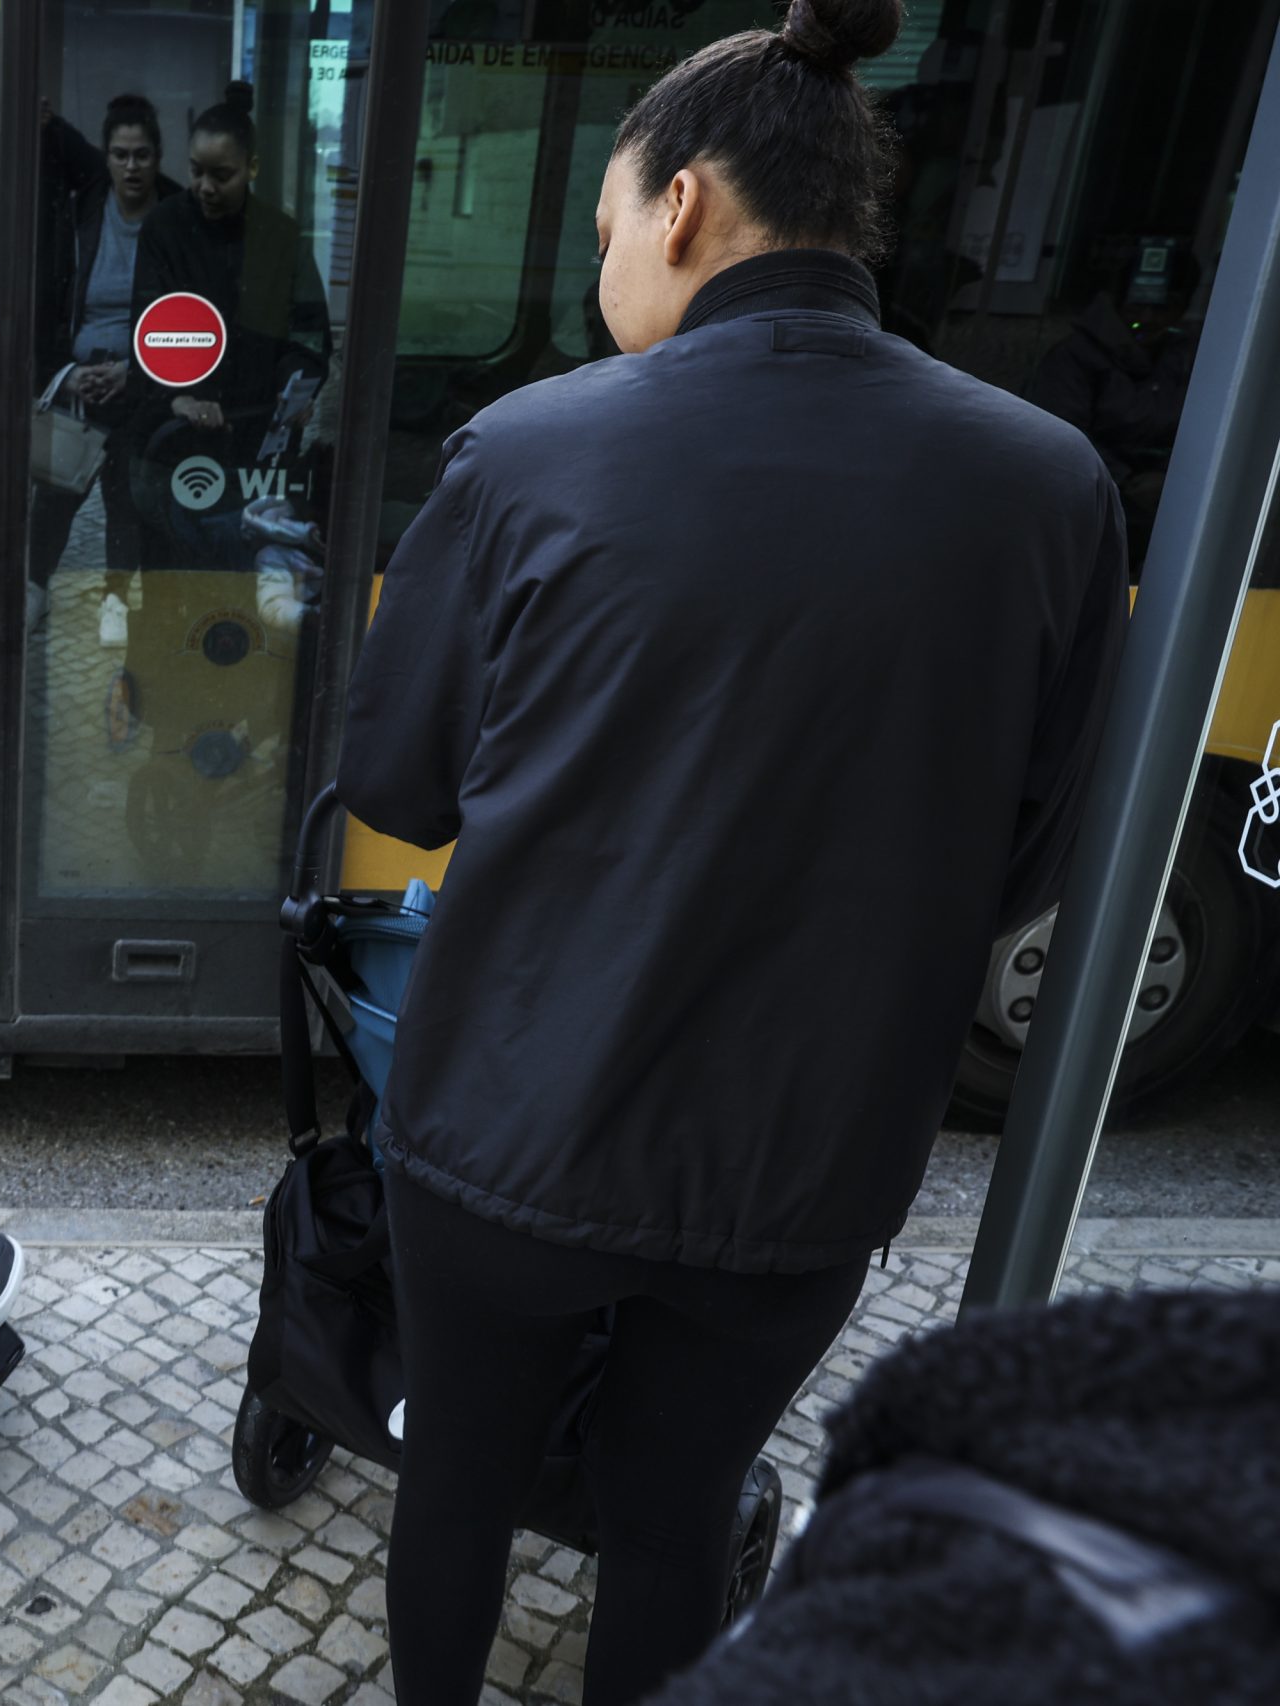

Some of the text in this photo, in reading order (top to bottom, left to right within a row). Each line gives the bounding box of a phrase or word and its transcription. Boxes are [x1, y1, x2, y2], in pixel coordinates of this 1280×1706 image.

[425, 43, 475, 65] AIDA
[483, 44, 514, 66] DE
[148, 335, 173, 343] Entrada
[175, 336, 190, 344] pela
[238, 468, 313, 501] WI-
